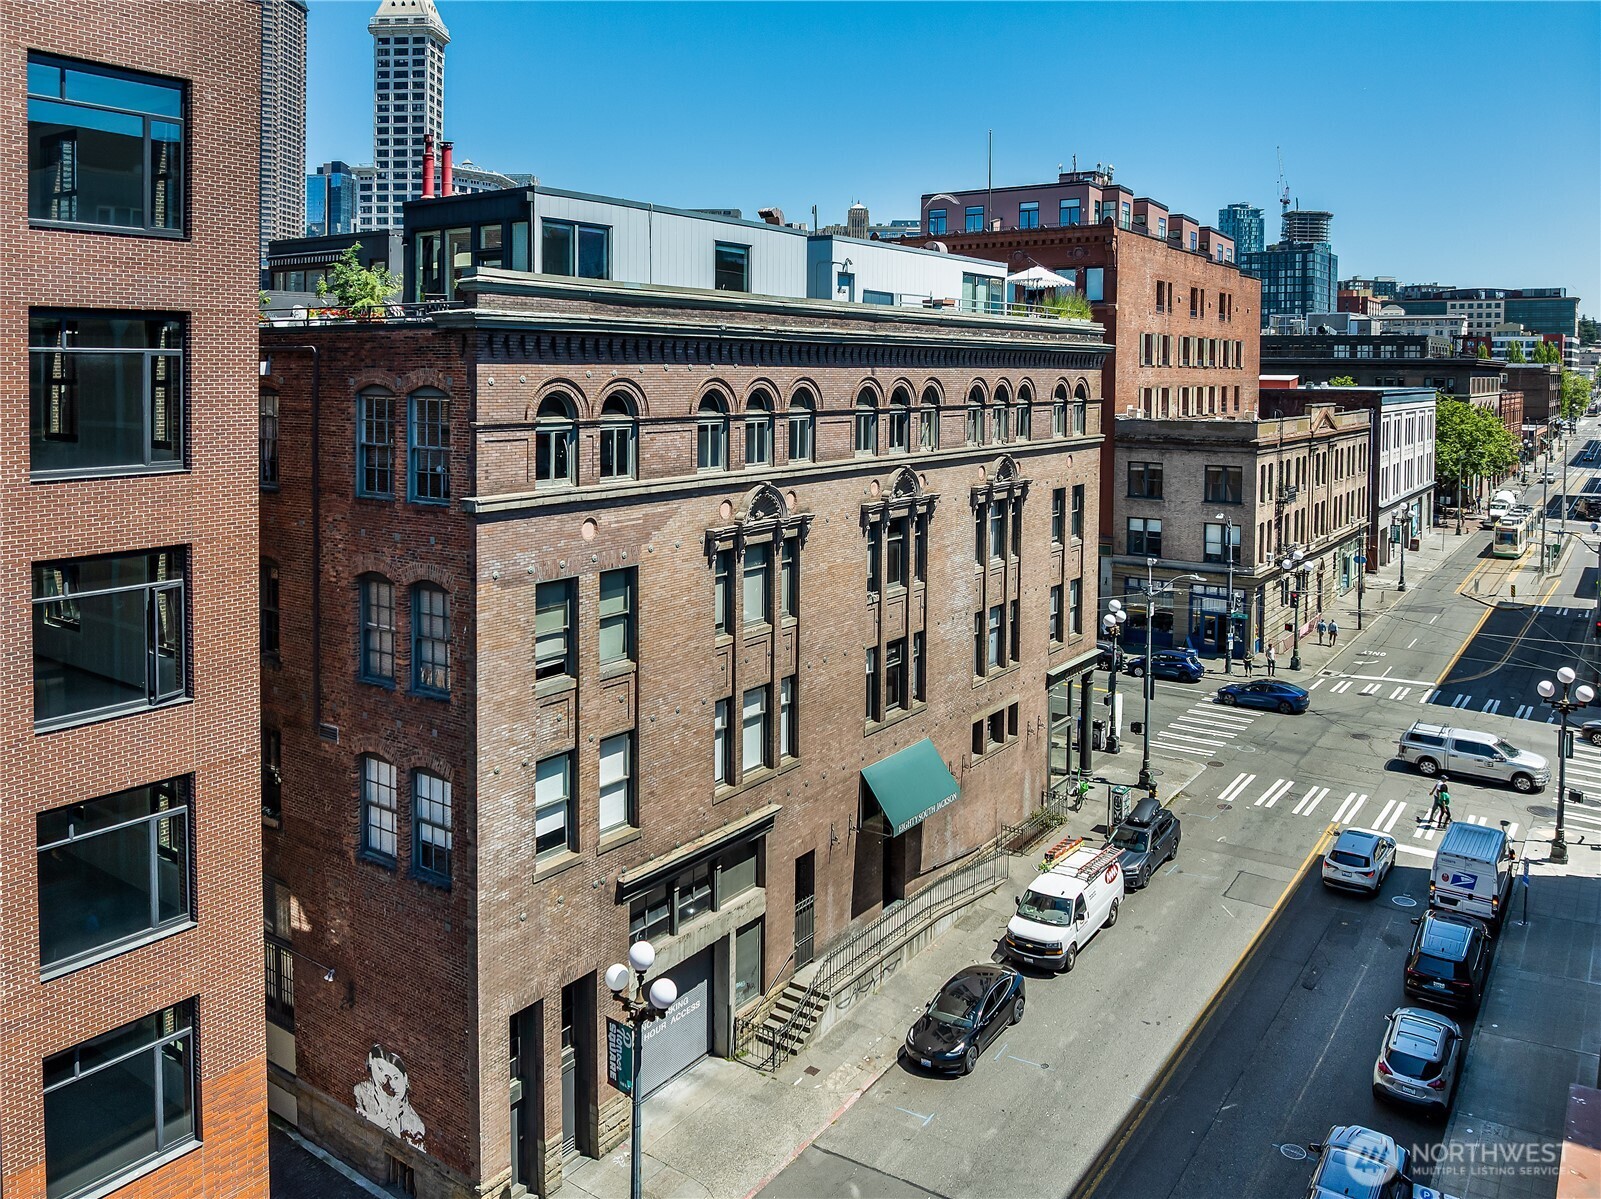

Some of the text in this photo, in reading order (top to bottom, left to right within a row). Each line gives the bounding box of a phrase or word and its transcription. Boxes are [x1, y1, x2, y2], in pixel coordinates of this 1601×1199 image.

[898, 792, 958, 833] EIGHTY SOUTH JACKSON
[644, 1000, 701, 1041] HOUR ACCESS
[608, 1022, 617, 1081] SQUARE
